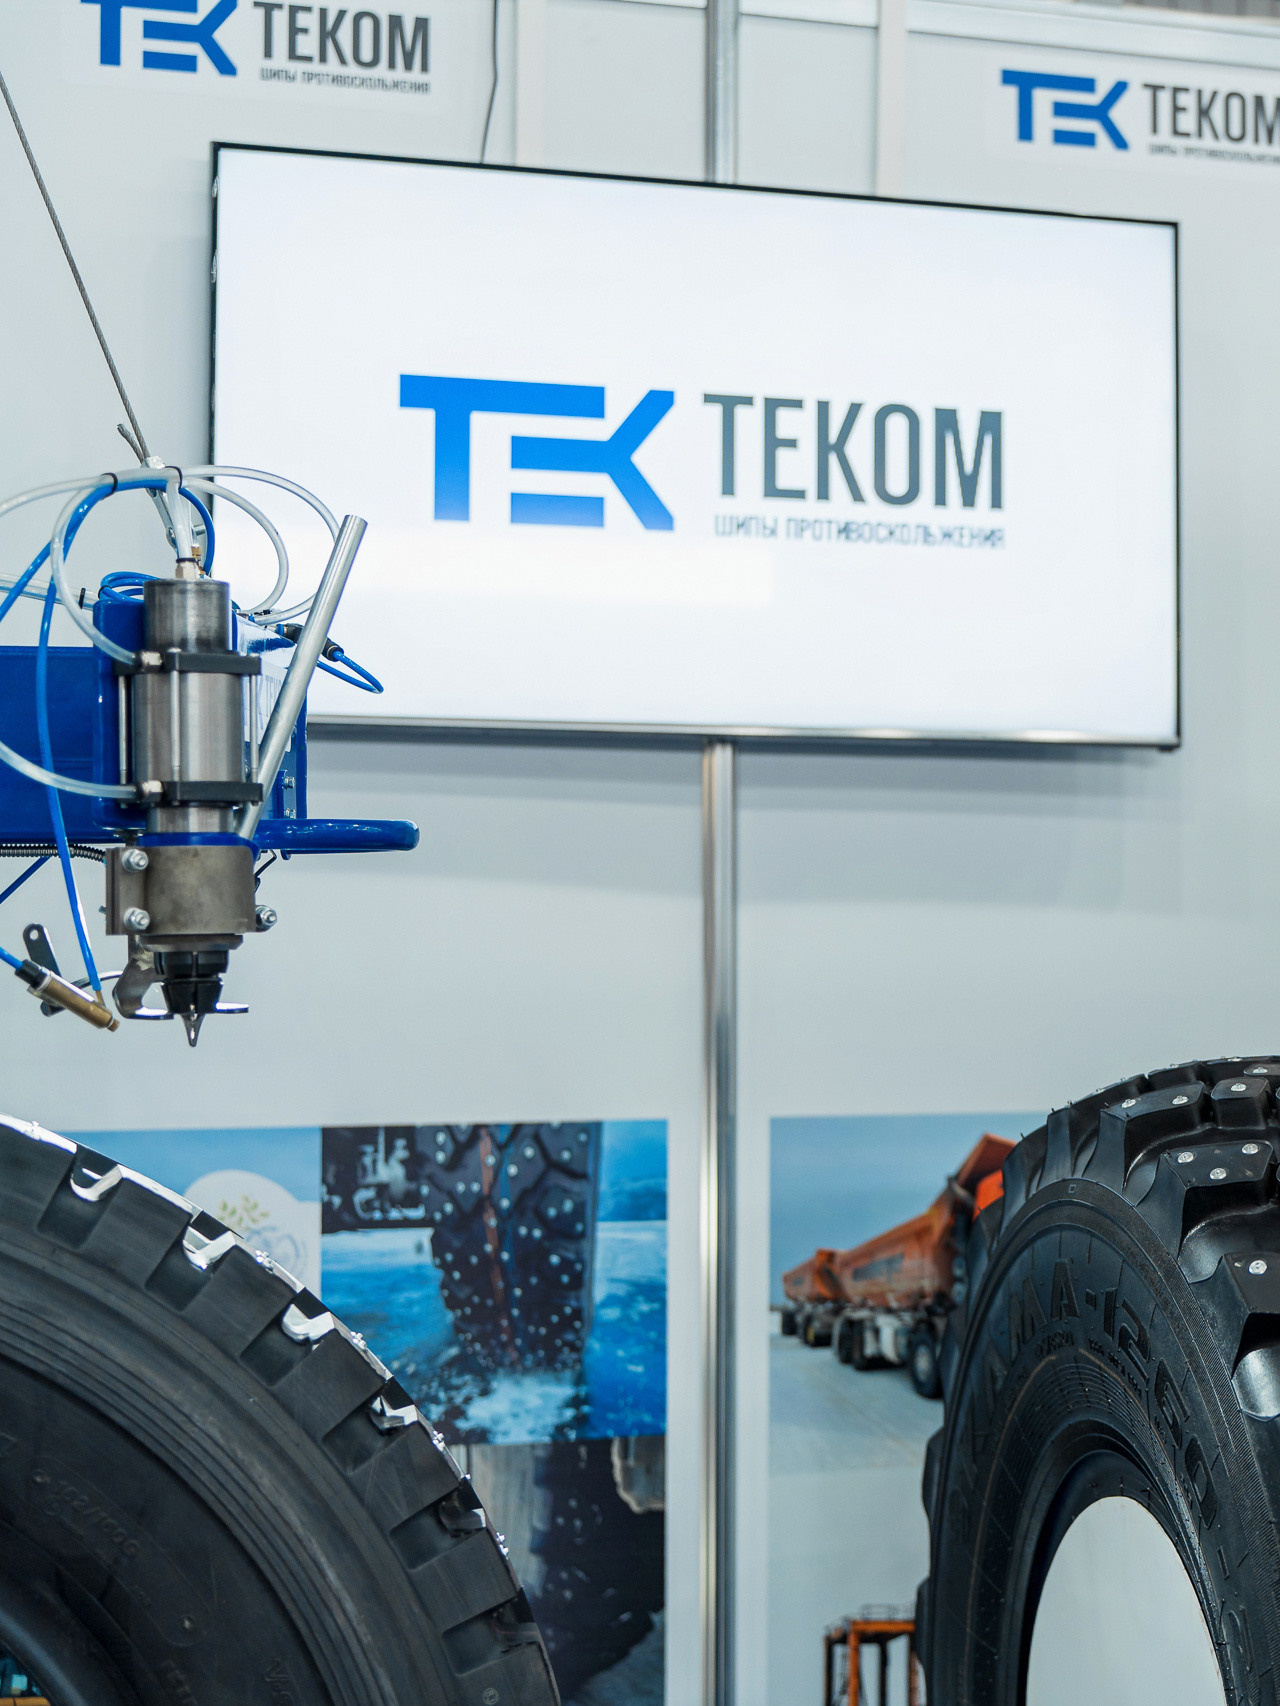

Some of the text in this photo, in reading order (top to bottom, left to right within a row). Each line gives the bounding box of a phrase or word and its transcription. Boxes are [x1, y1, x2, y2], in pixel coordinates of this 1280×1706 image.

[253, 1, 431, 74] ТЕКОМ
[703, 393, 1004, 511] ТЕКОМ
[714, 513, 1006, 550] ШИПЫ ПРОТИВОСКОЛЬЖЕНИЯ
